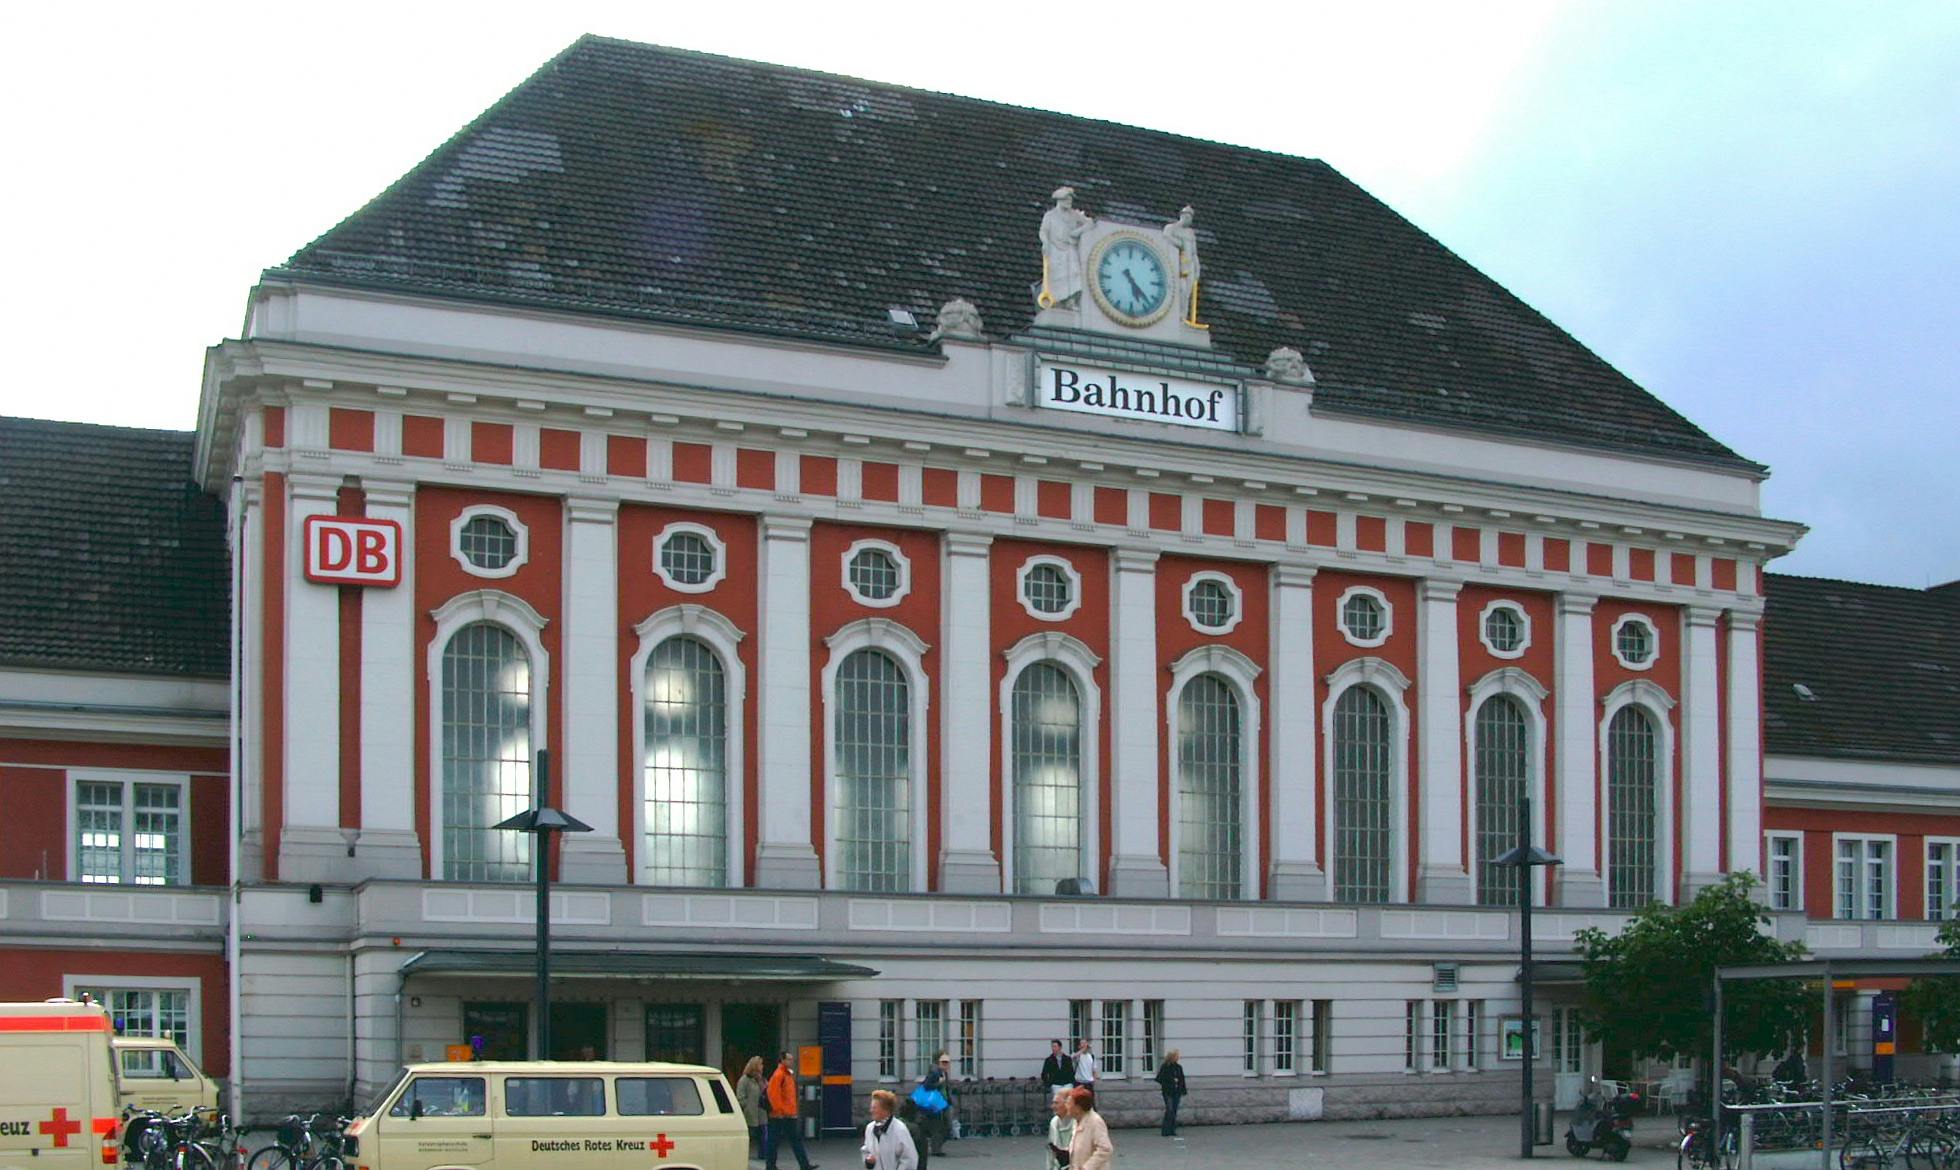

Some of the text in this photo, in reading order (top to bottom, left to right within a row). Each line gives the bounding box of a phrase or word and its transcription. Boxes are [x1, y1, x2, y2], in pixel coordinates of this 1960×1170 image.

[1051, 367, 1223, 422] Bahnhof
[319, 526, 388, 574] DB
[531, 1139, 645, 1152] Deutsches Rotes Kreuz
